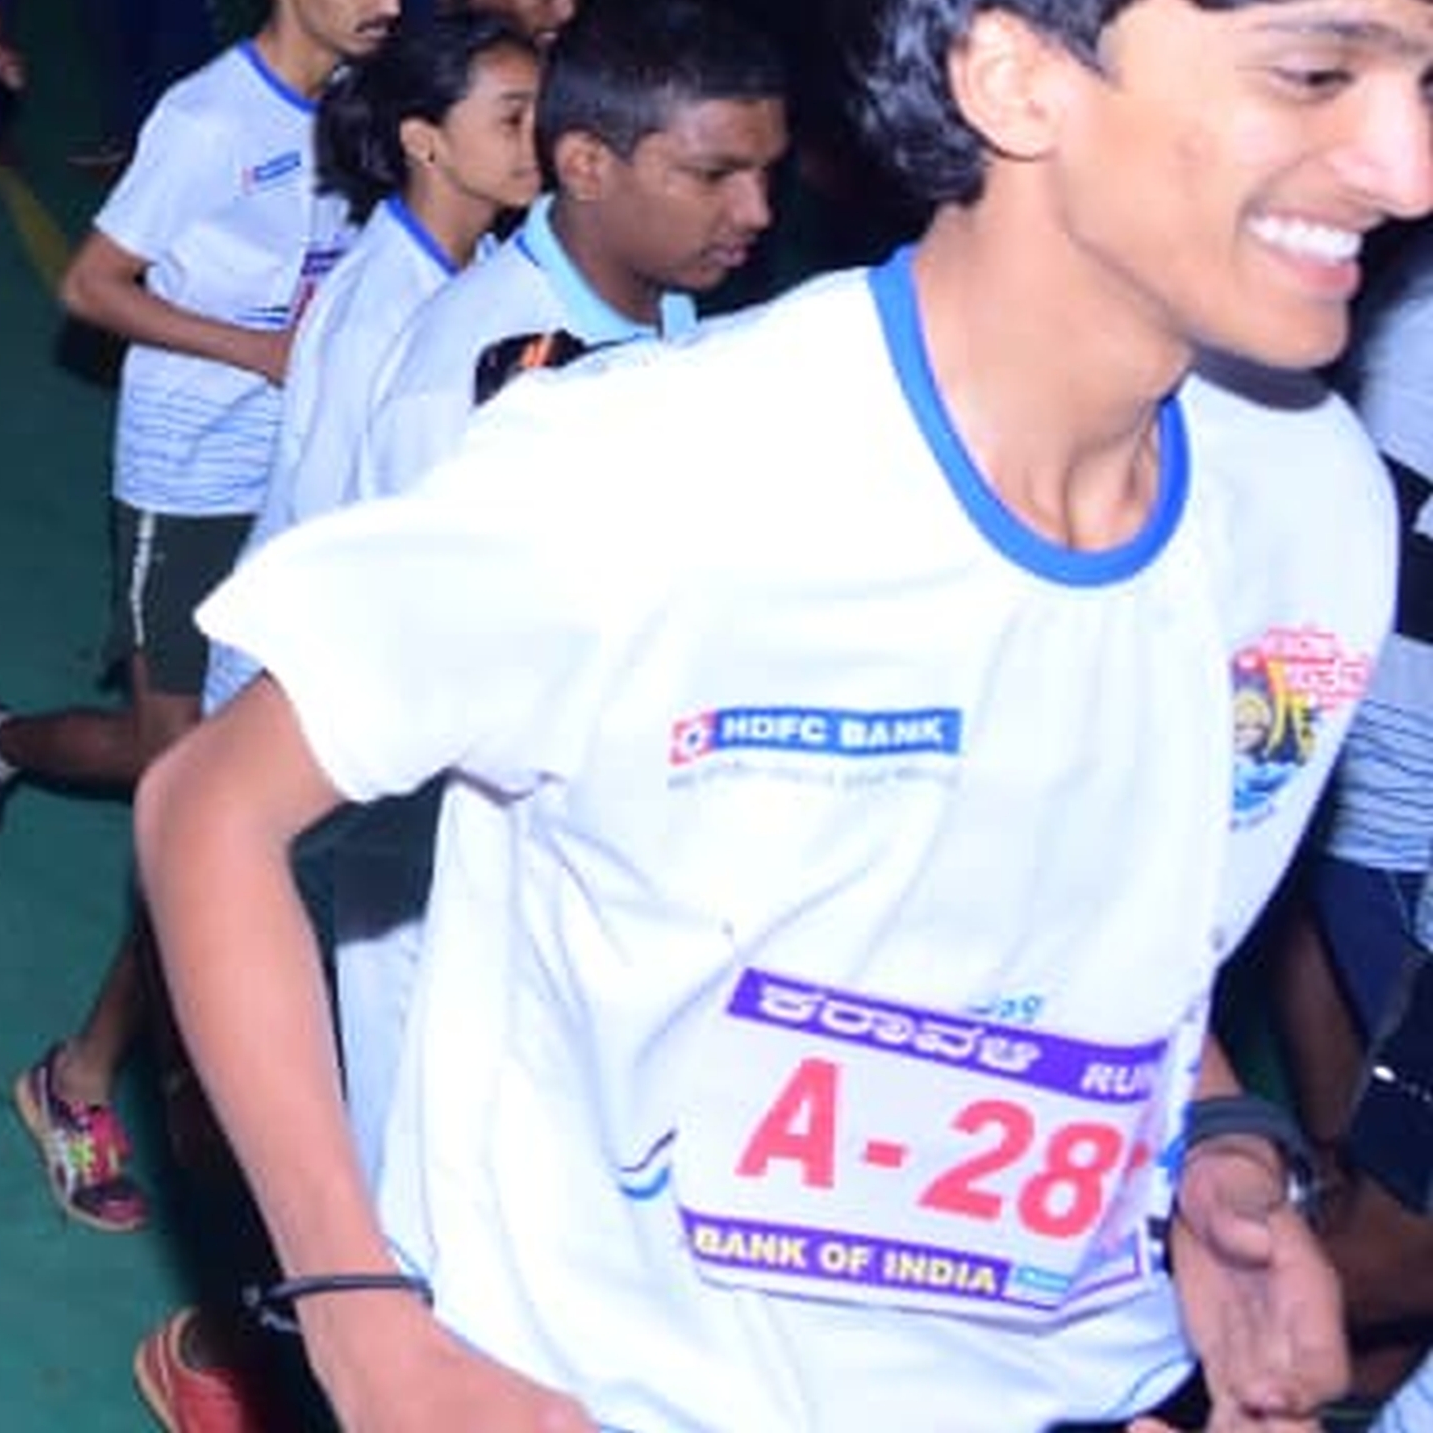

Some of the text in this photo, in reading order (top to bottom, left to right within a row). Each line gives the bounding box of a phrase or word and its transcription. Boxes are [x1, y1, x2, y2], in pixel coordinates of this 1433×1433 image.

[722, 714, 944, 748] HDFC BANK
[694, 1226, 1000, 1295] BANK OF INDIA
